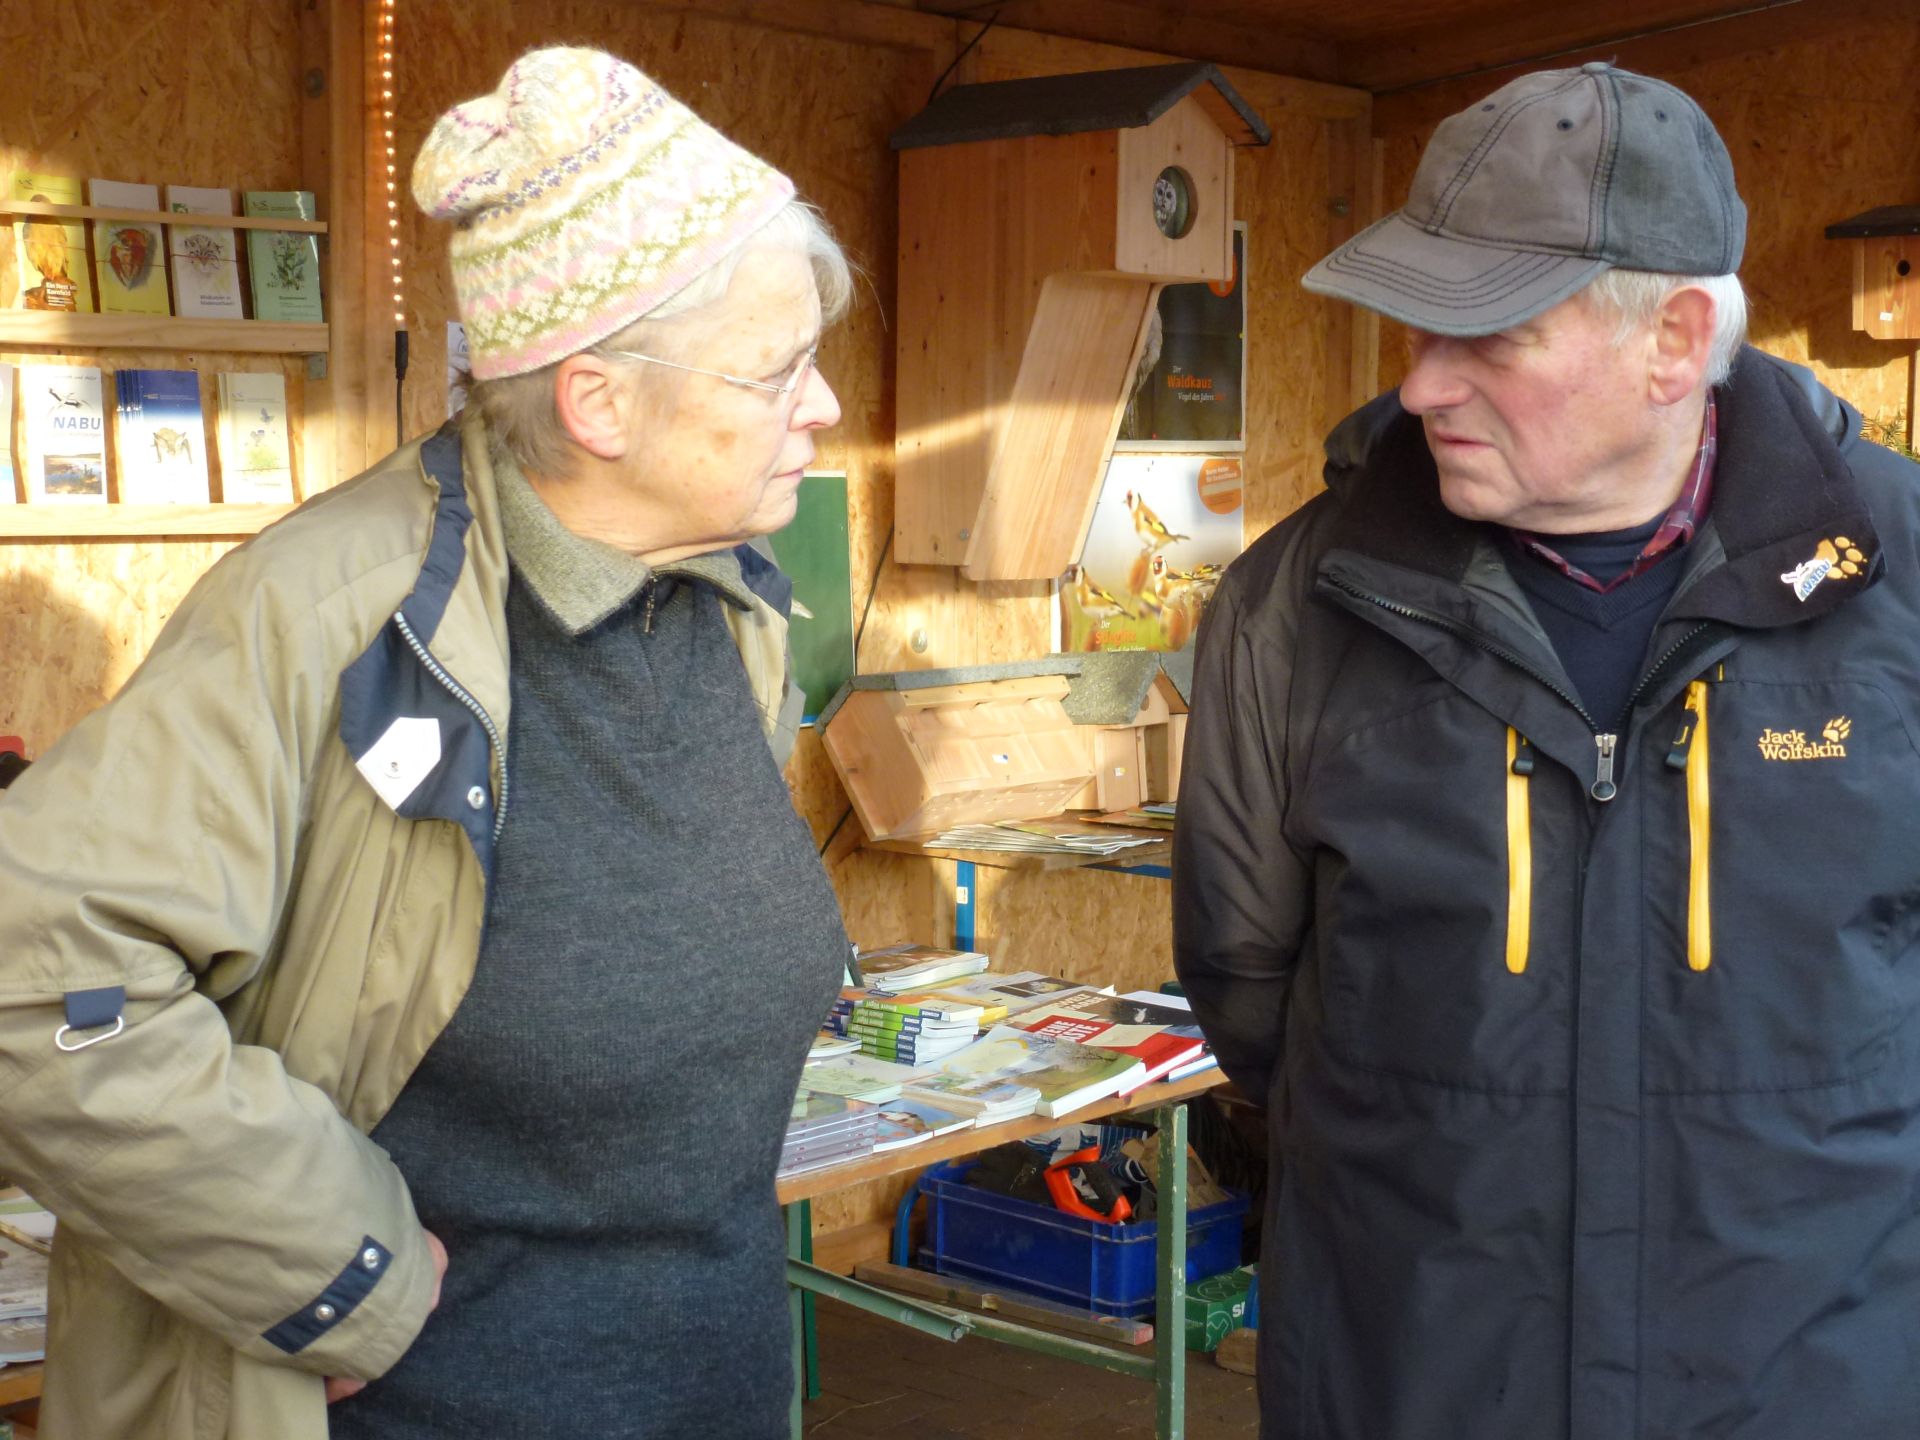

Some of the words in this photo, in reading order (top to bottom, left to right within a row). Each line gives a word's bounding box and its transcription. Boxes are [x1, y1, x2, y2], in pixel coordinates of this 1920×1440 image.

[1167, 374, 1213, 389] Waldkauz
[1178, 392, 1191, 402] Vogel
[54, 416, 102, 430] NABU
[1802, 560, 1830, 596] NABU
[1101, 620, 1111, 629] Der
[1759, 728, 1807, 745] Jack
[1758, 740, 1847, 760] Wolfskin
